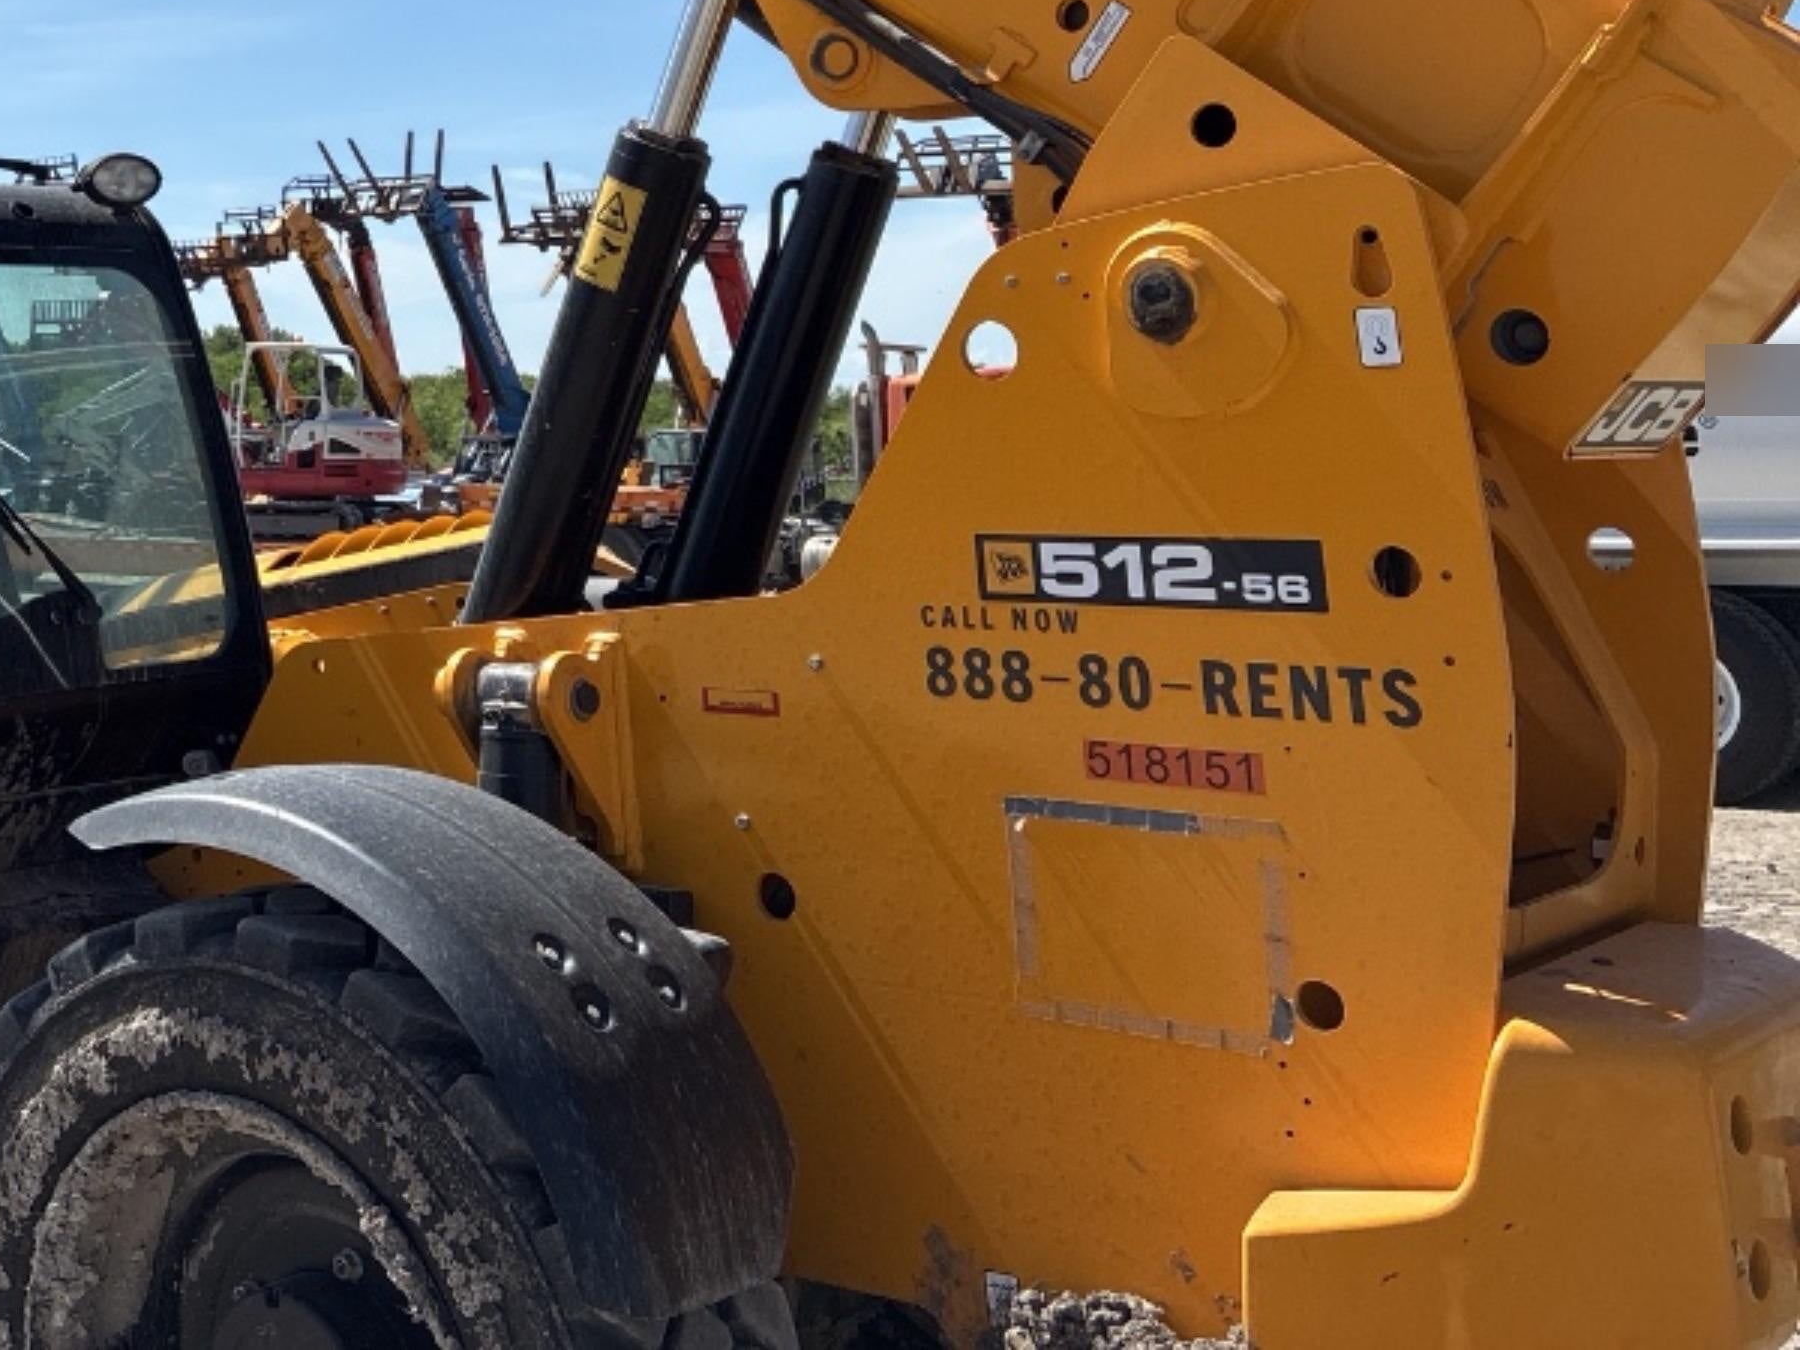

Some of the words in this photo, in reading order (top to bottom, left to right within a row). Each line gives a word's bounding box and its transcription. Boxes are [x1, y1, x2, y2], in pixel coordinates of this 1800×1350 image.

[1585, 386, 1705, 442] JCB
[919, 604, 995, 631] CALL
[1011, 607, 1081, 635] NOW
[925, 645, 1424, 730] 888-80-RENTS
[1086, 739, 1257, 794] 518151
